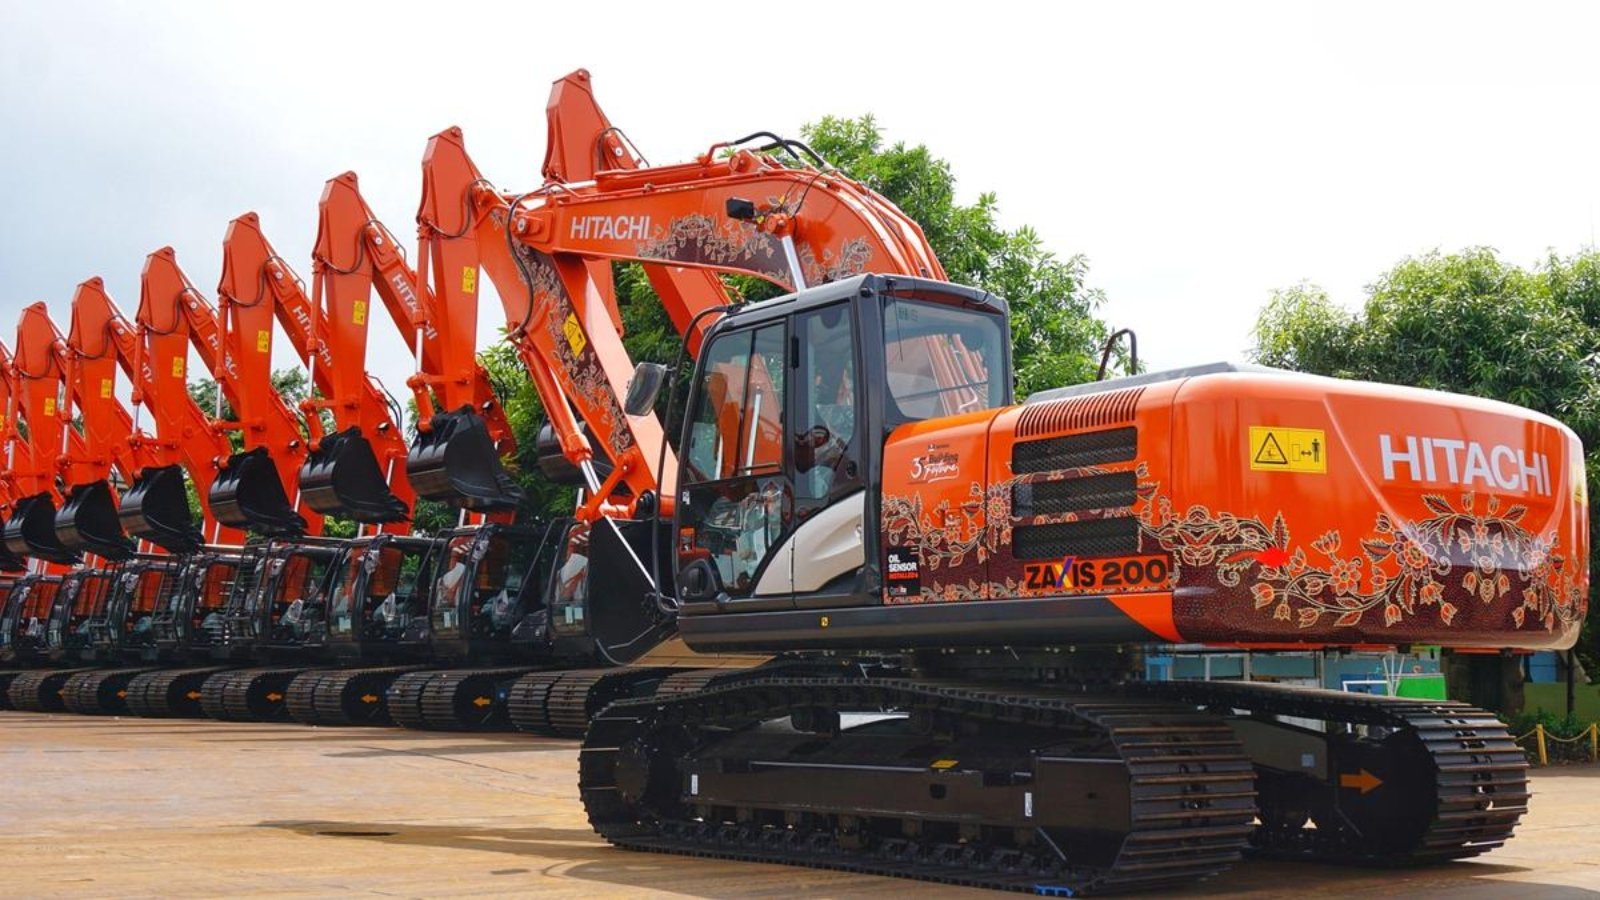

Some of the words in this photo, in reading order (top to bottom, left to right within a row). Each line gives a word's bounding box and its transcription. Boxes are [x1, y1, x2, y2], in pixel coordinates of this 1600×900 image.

[570, 215, 651, 240] HITACHI
[392, 273, 438, 340] HITAHI
[1379, 434, 1552, 497] HITACHI
[888, 554, 900, 564] OIL
[888, 562, 917, 572] SENSOR
[1026, 557, 1096, 590] ZAXIS
[1101, 559, 1167, 586] 200
